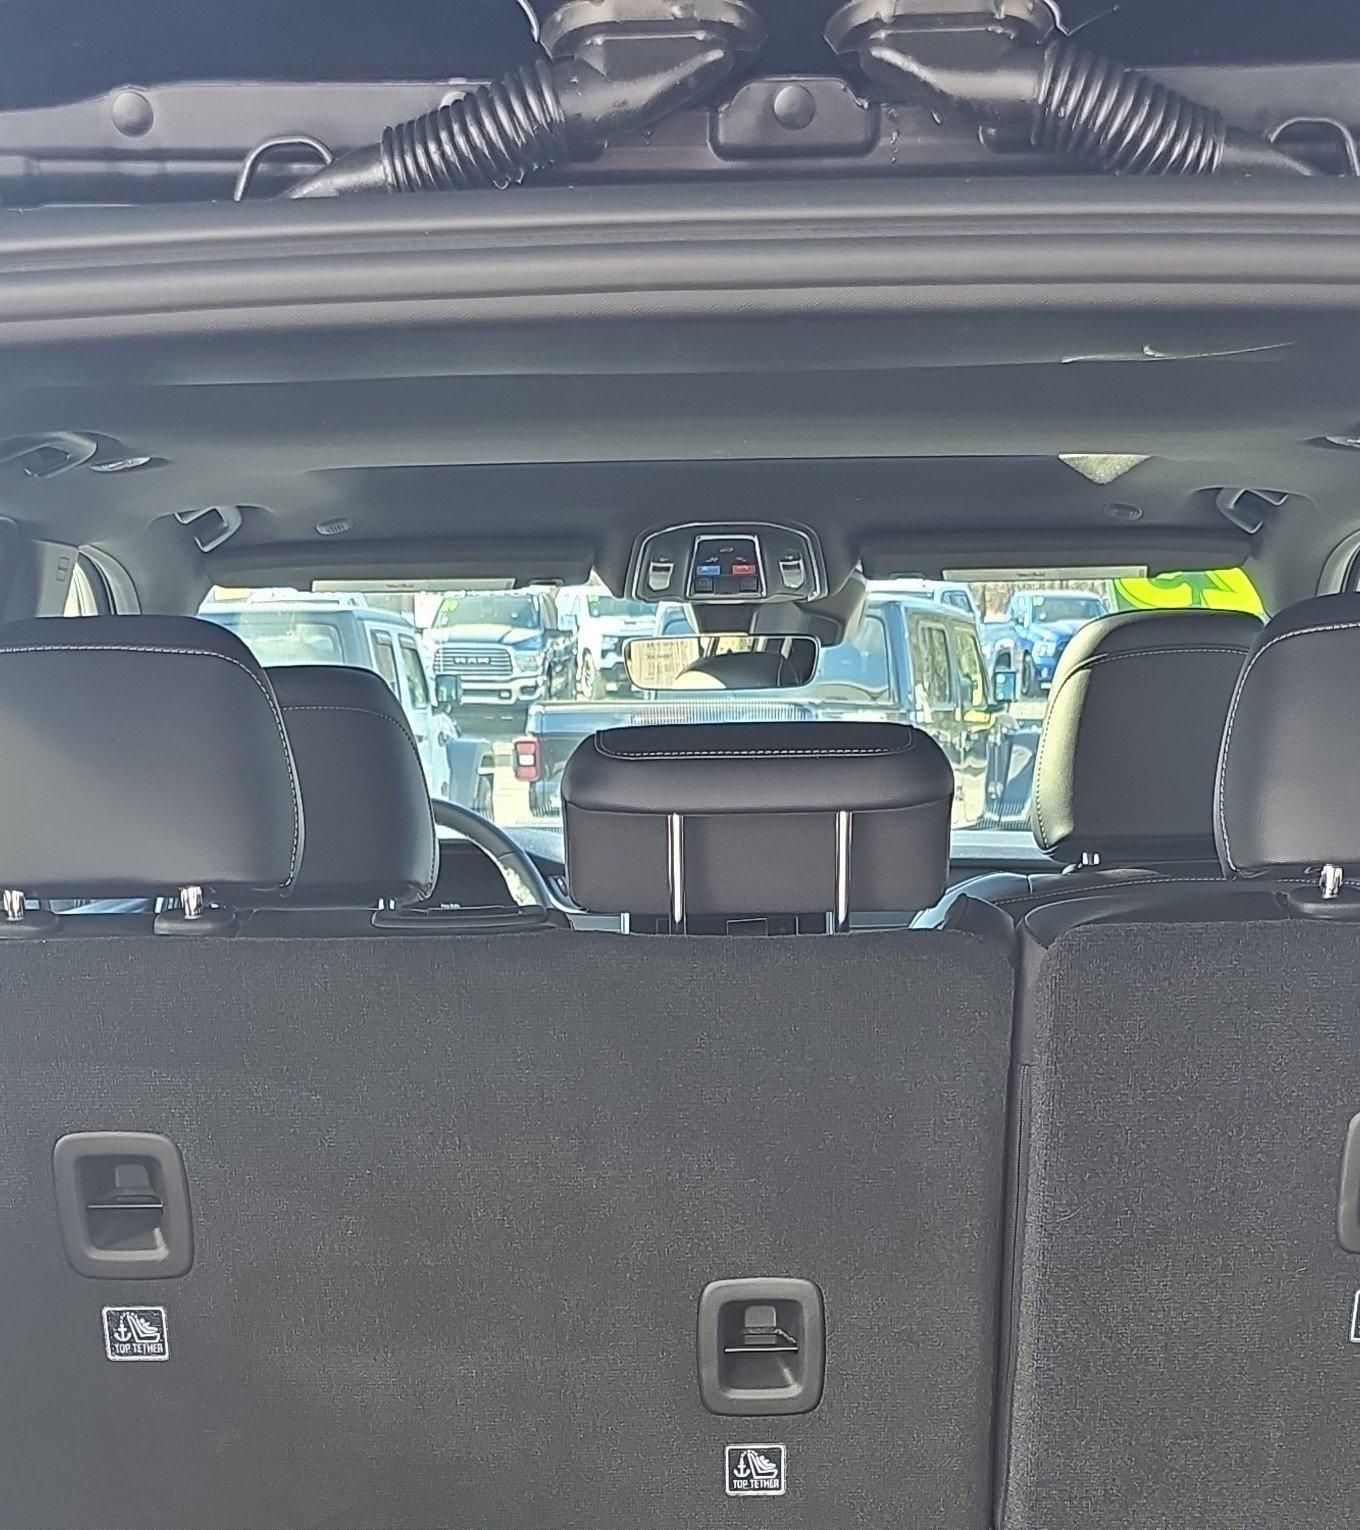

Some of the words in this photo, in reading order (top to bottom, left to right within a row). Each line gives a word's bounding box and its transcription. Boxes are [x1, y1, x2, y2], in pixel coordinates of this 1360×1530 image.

[115, 1343, 131, 1354] TOP
[132, 1343, 164, 1355] TETHER
[733, 1479, 748, 1489] TOP
[750, 1479, 780, 1489] TETHER
